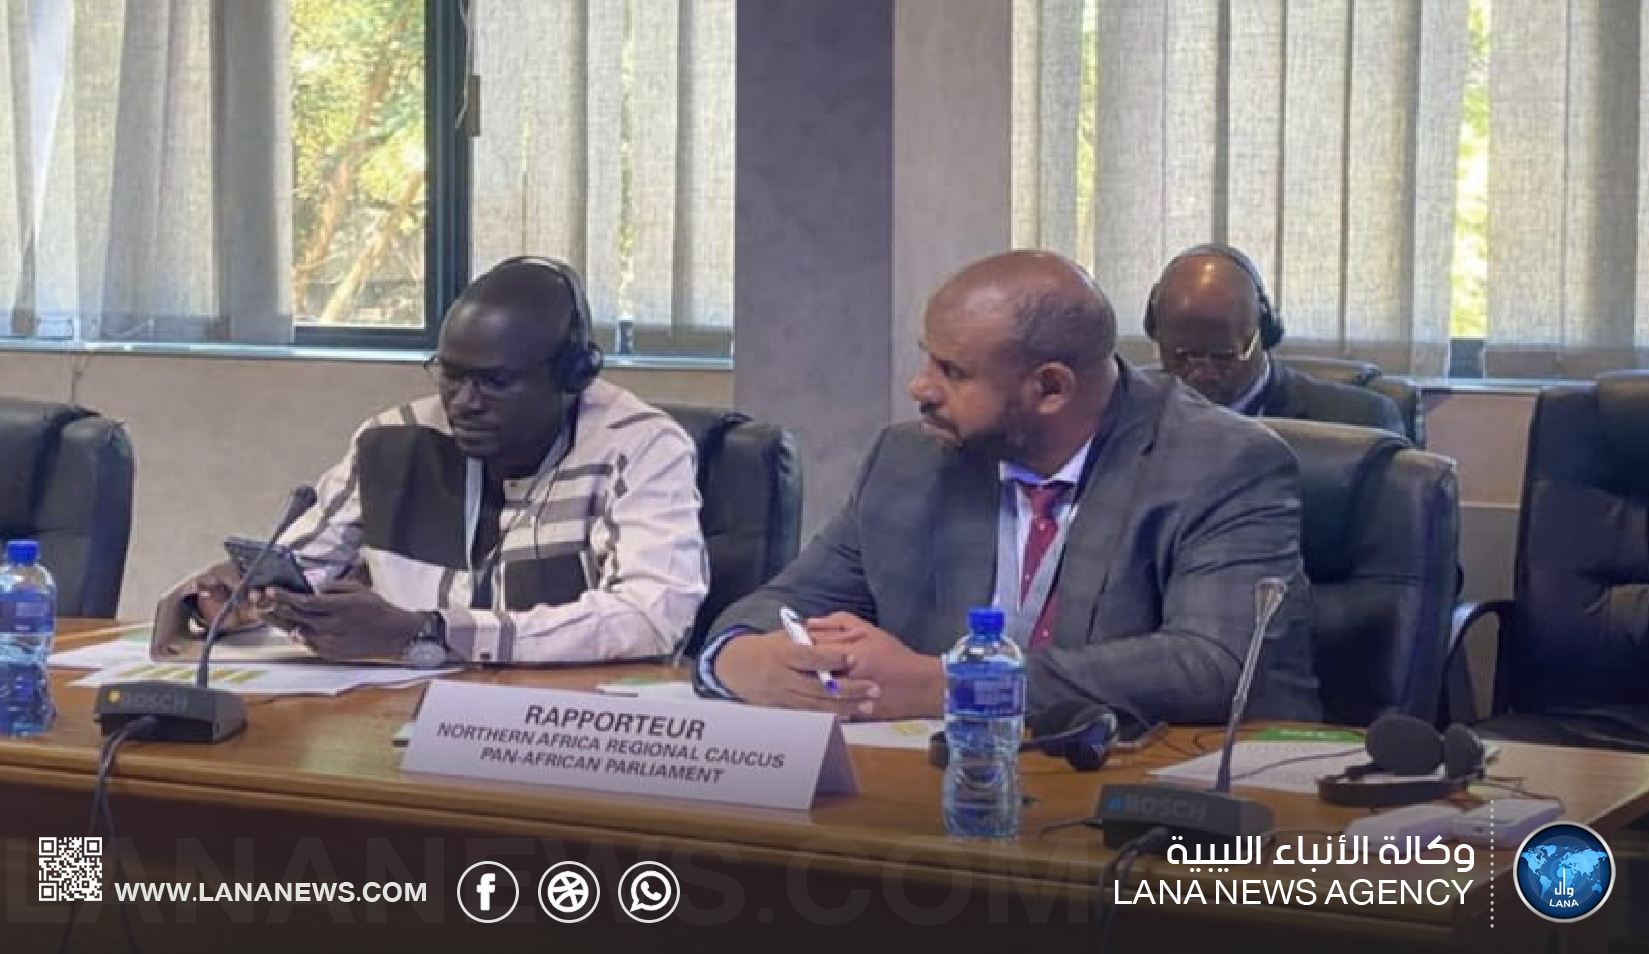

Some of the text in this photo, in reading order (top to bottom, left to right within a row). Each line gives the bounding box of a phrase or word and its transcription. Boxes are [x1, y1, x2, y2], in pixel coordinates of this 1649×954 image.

[524, 703, 706, 742] RAPPORTEUR
[436, 721, 786, 769] NORTHERN AFRICA REGIONAL CAUCUS
[479, 746, 725, 786] PAN-AFRICAN PARLIAMENT
[1126, 793, 1207, 823] BOSCH
